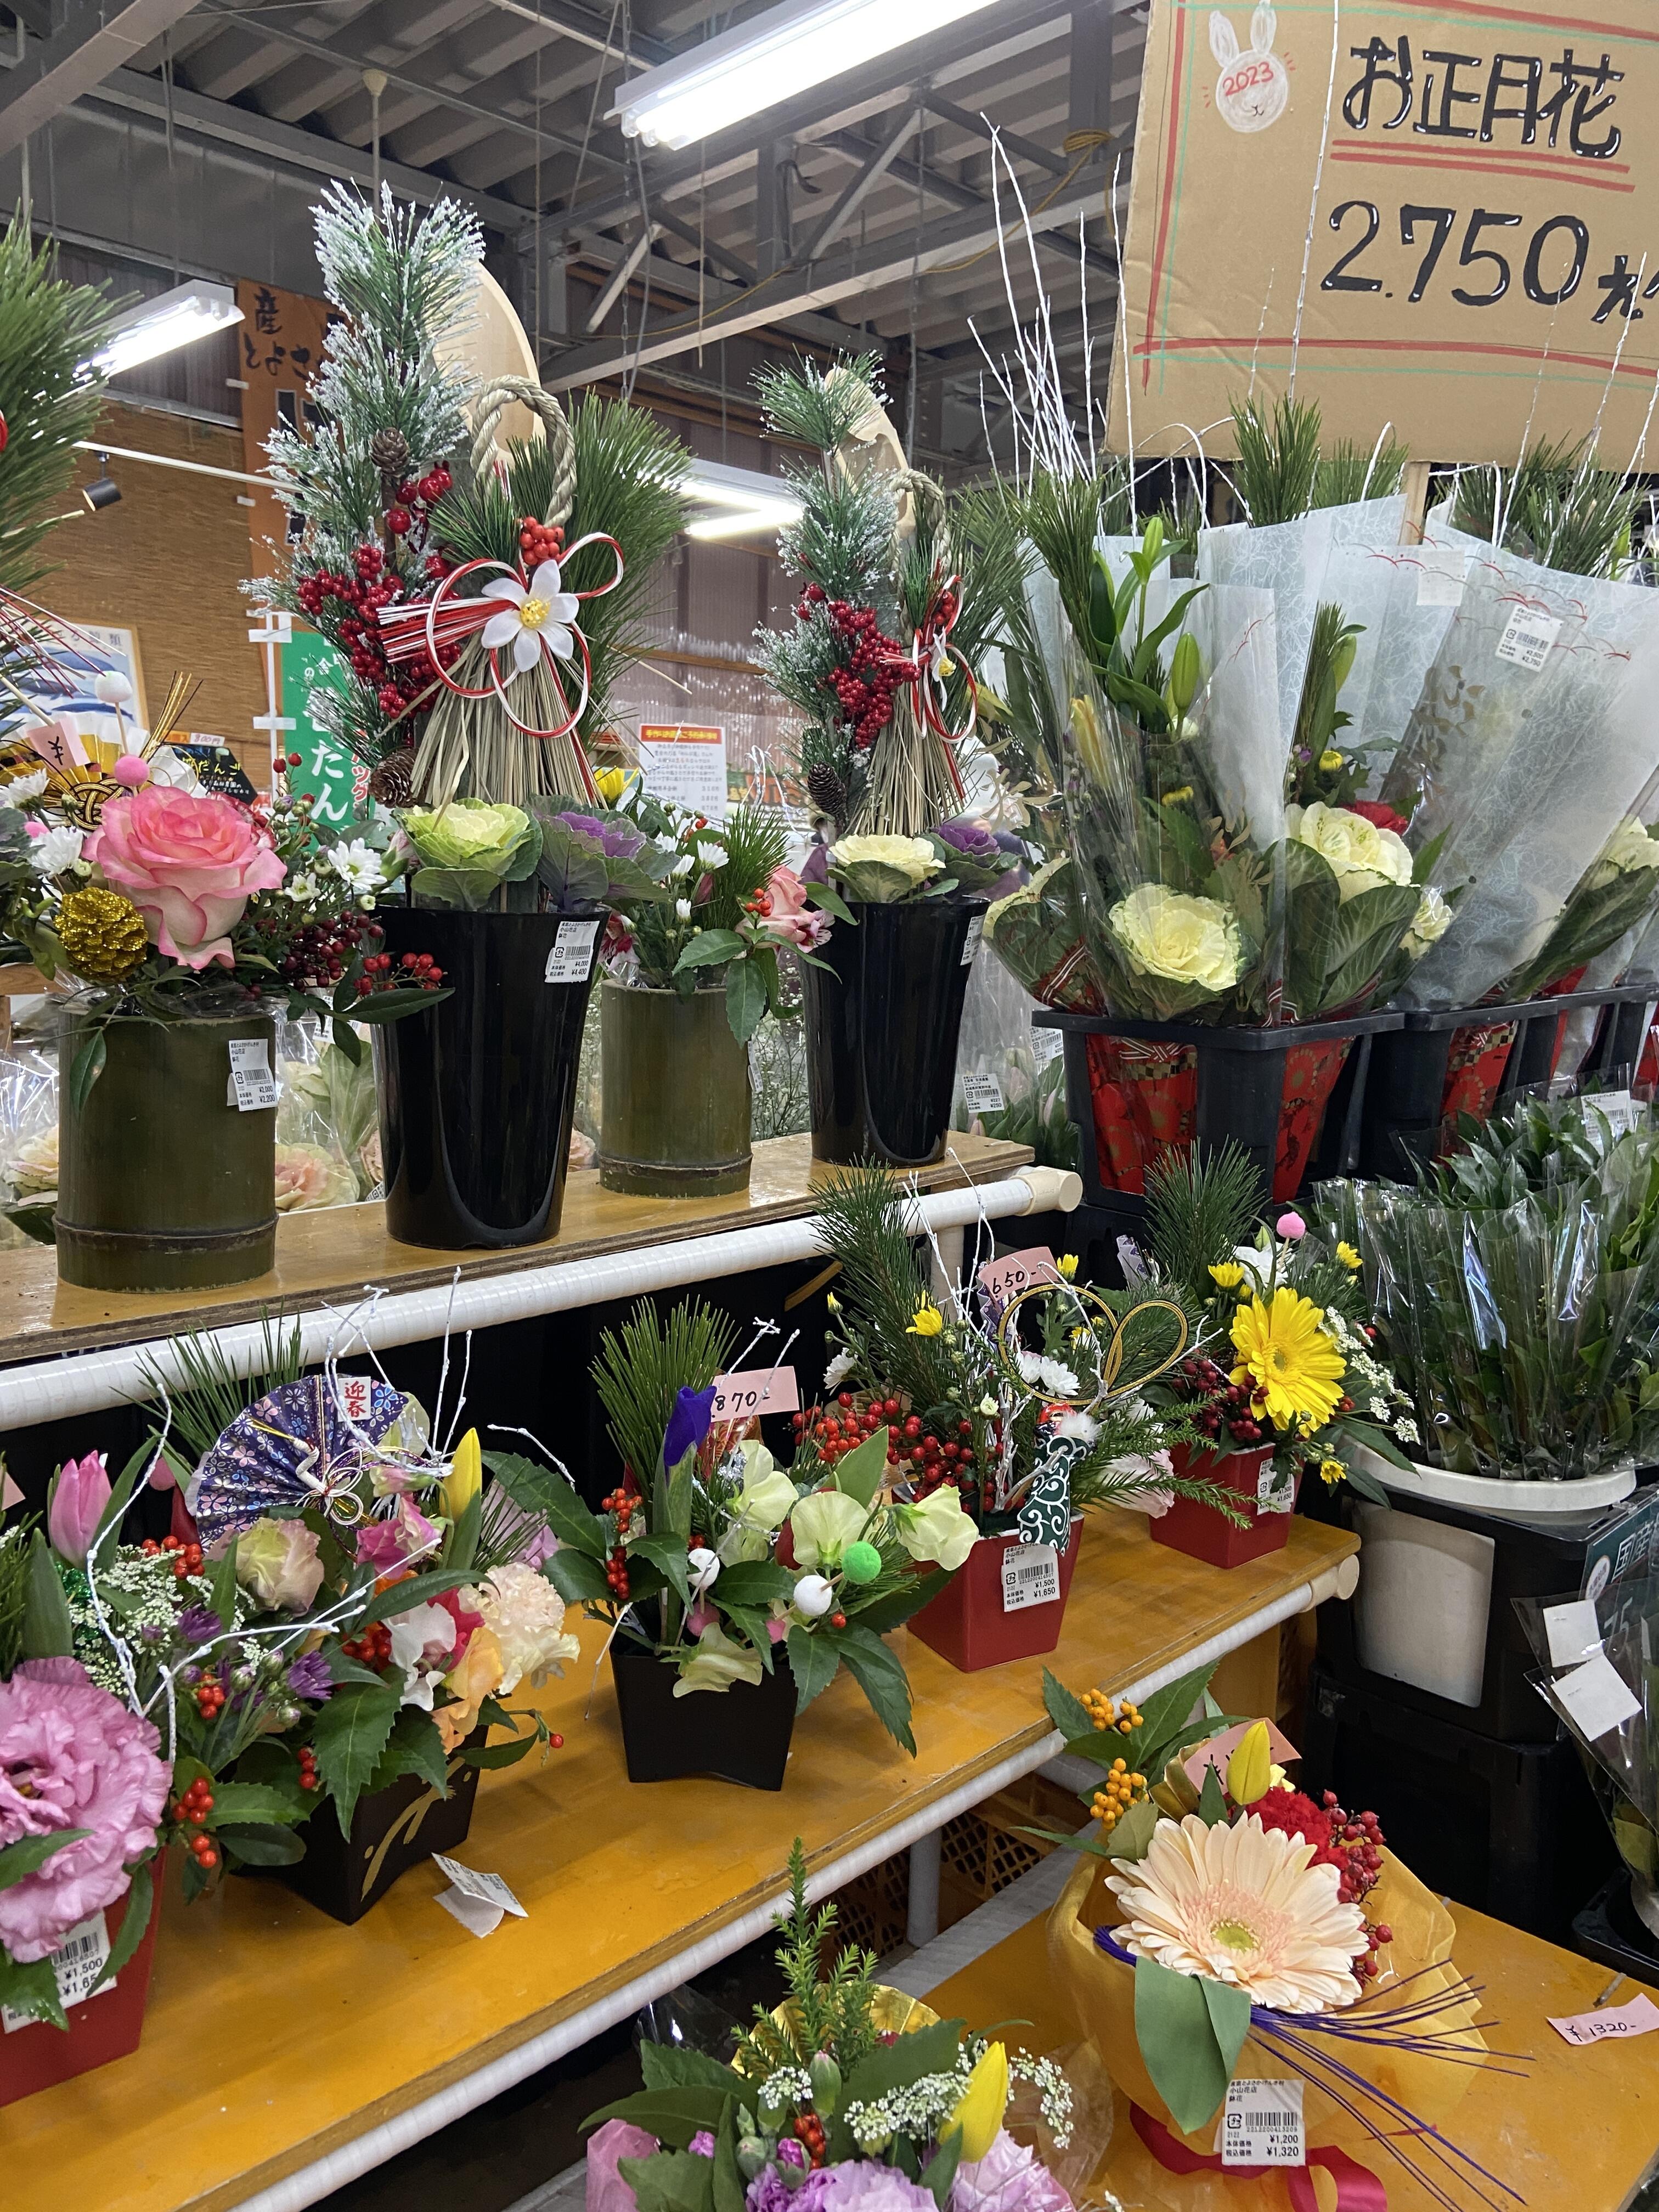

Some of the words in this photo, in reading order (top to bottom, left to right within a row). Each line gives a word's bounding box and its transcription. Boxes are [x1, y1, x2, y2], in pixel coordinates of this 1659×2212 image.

[1223, 61, 1274, 96] 2023
[1342, 35, 1625, 158] お正月花
[345, 1381, 366, 1418] 迎春
[1035, 1579, 1054, 1588] ¥1,500
[1007, 1596, 1024, 1605] 税込価格
[1034, 1587, 1055, 1598] ¥1,650
[65, 1958, 103, 1979] ¥1,500
[63, 1973, 96, 1995] ¥1,65
[1269, 2135, 1298, 2144] ¥1,200
[1267, 2147, 1299, 2157] ¥1,320
